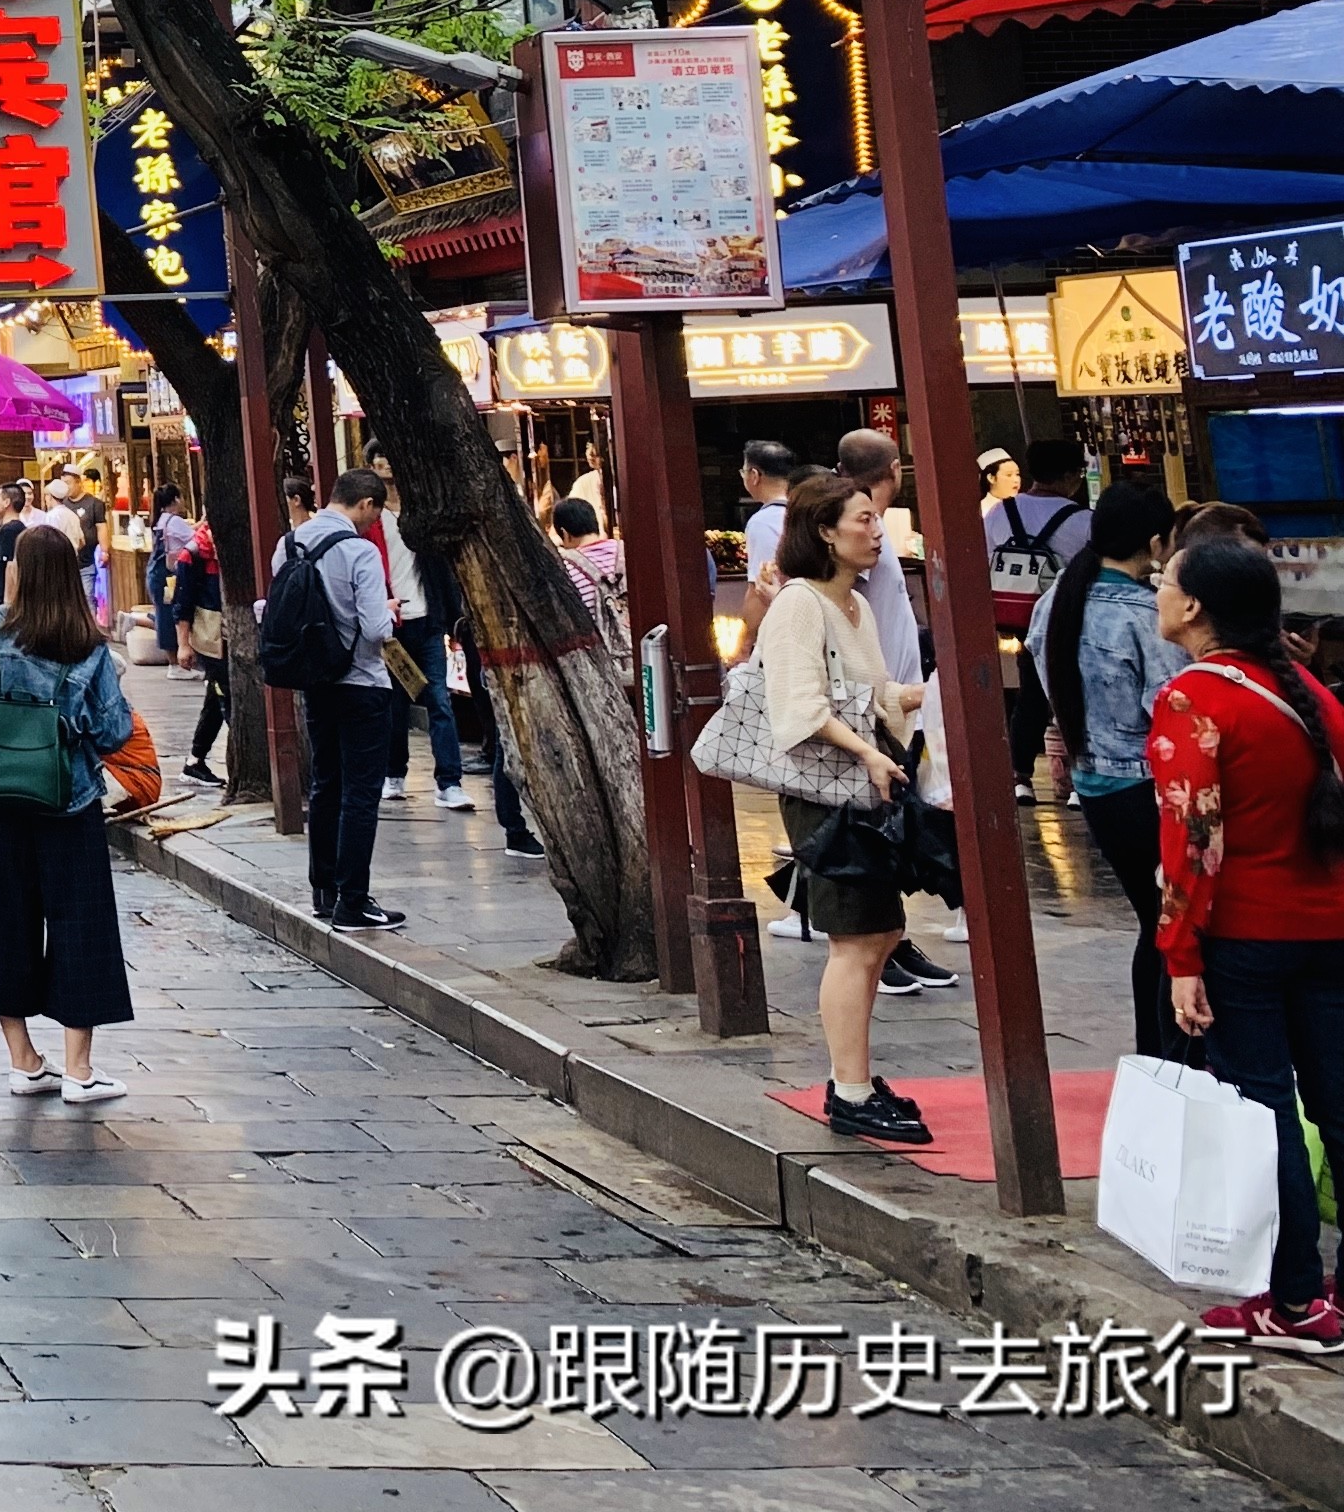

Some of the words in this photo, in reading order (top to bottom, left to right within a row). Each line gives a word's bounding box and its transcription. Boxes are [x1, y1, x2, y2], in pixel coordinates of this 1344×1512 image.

[671, 64, 735, 76] 请立即举报
[1193, 265, 1344, 350] 老酸奶
